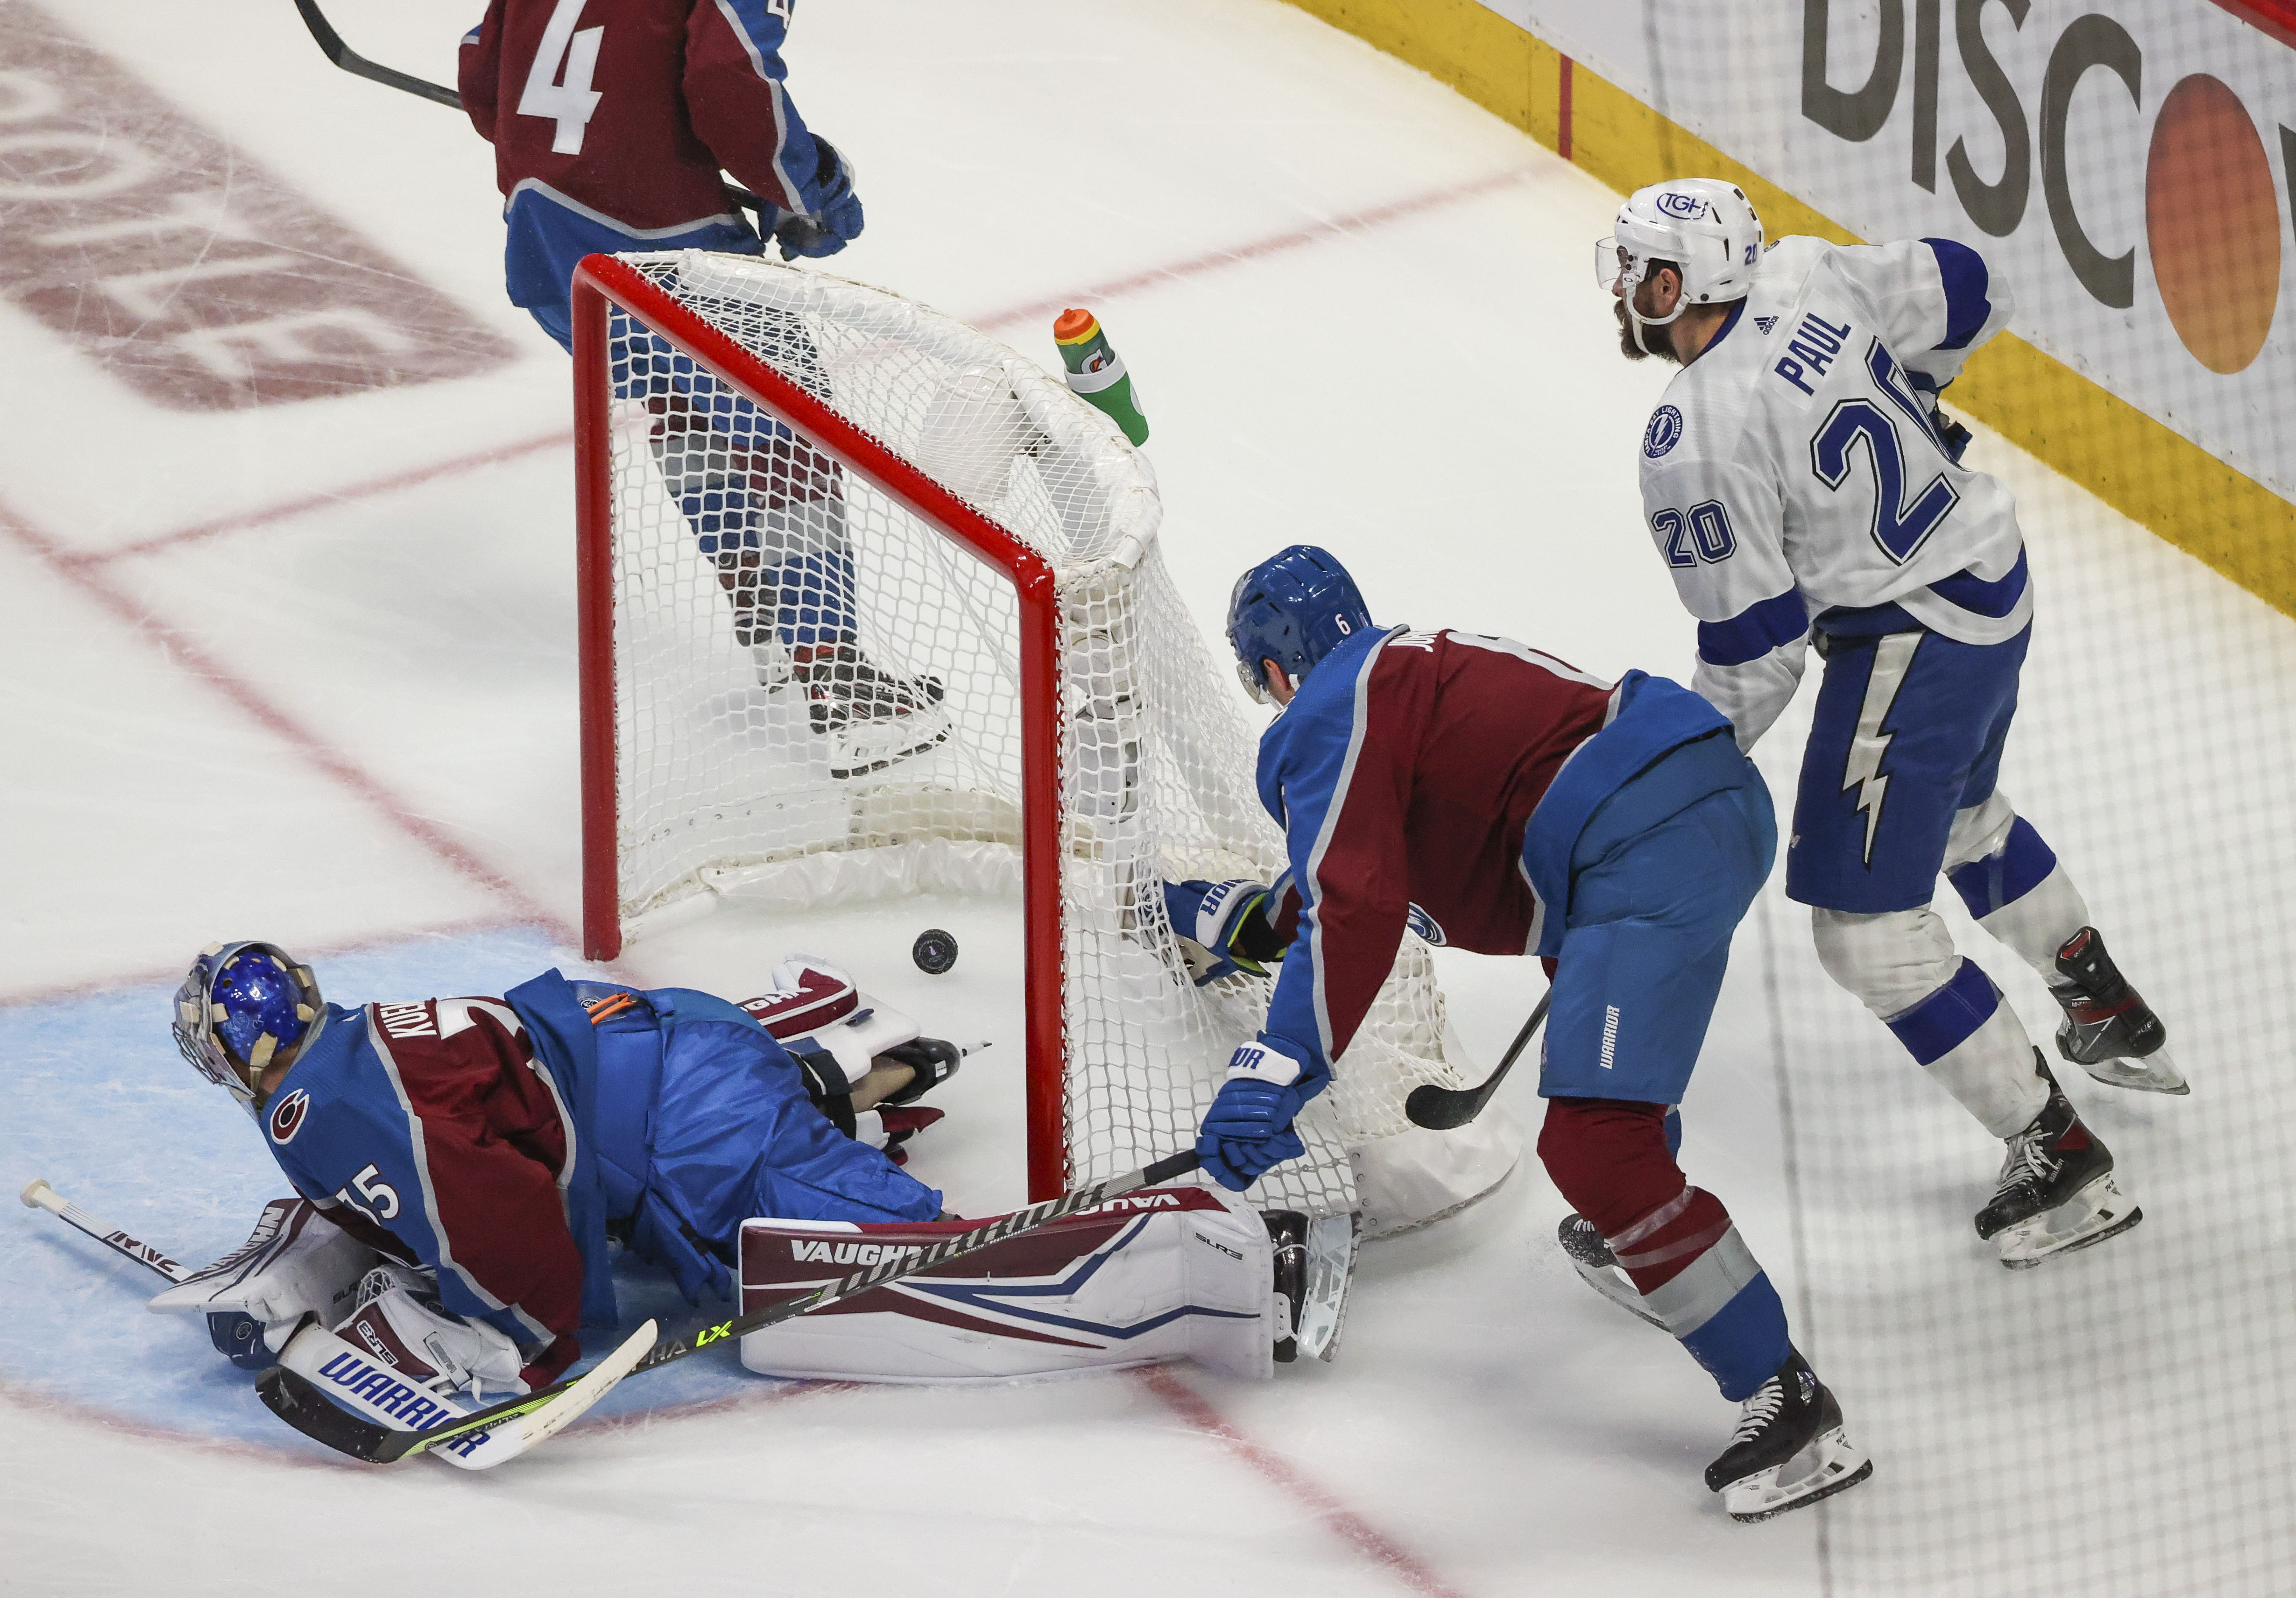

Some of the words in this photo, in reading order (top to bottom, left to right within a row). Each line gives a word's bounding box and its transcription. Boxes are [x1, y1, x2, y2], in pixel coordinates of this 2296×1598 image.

[517, 0, 605, 155] 4
[1801, 0, 2296, 375] DISCO
[1665, 193, 1708, 217] TGH
[1745, 243, 1757, 265] 20
[1763, 315, 1779, 335] adidas
[1774, 313, 1851, 396] PAUL
[1661, 406, 1682, 438] LIGHTNING
[1651, 499, 1737, 568] 20
[1335, 614, 1351, 635] 6
[1200, 879, 1255, 916] IOR
[1600, 1004, 1620, 1070] WARRIOR
[1230, 1047, 1265, 1069] OR
[1196, 1232, 1243, 1260] SLR3
[359, 1322, 397, 1365] SLR3
[696, 1320, 732, 1348] LX
[318, 1352, 490, 1458] WARRIR
